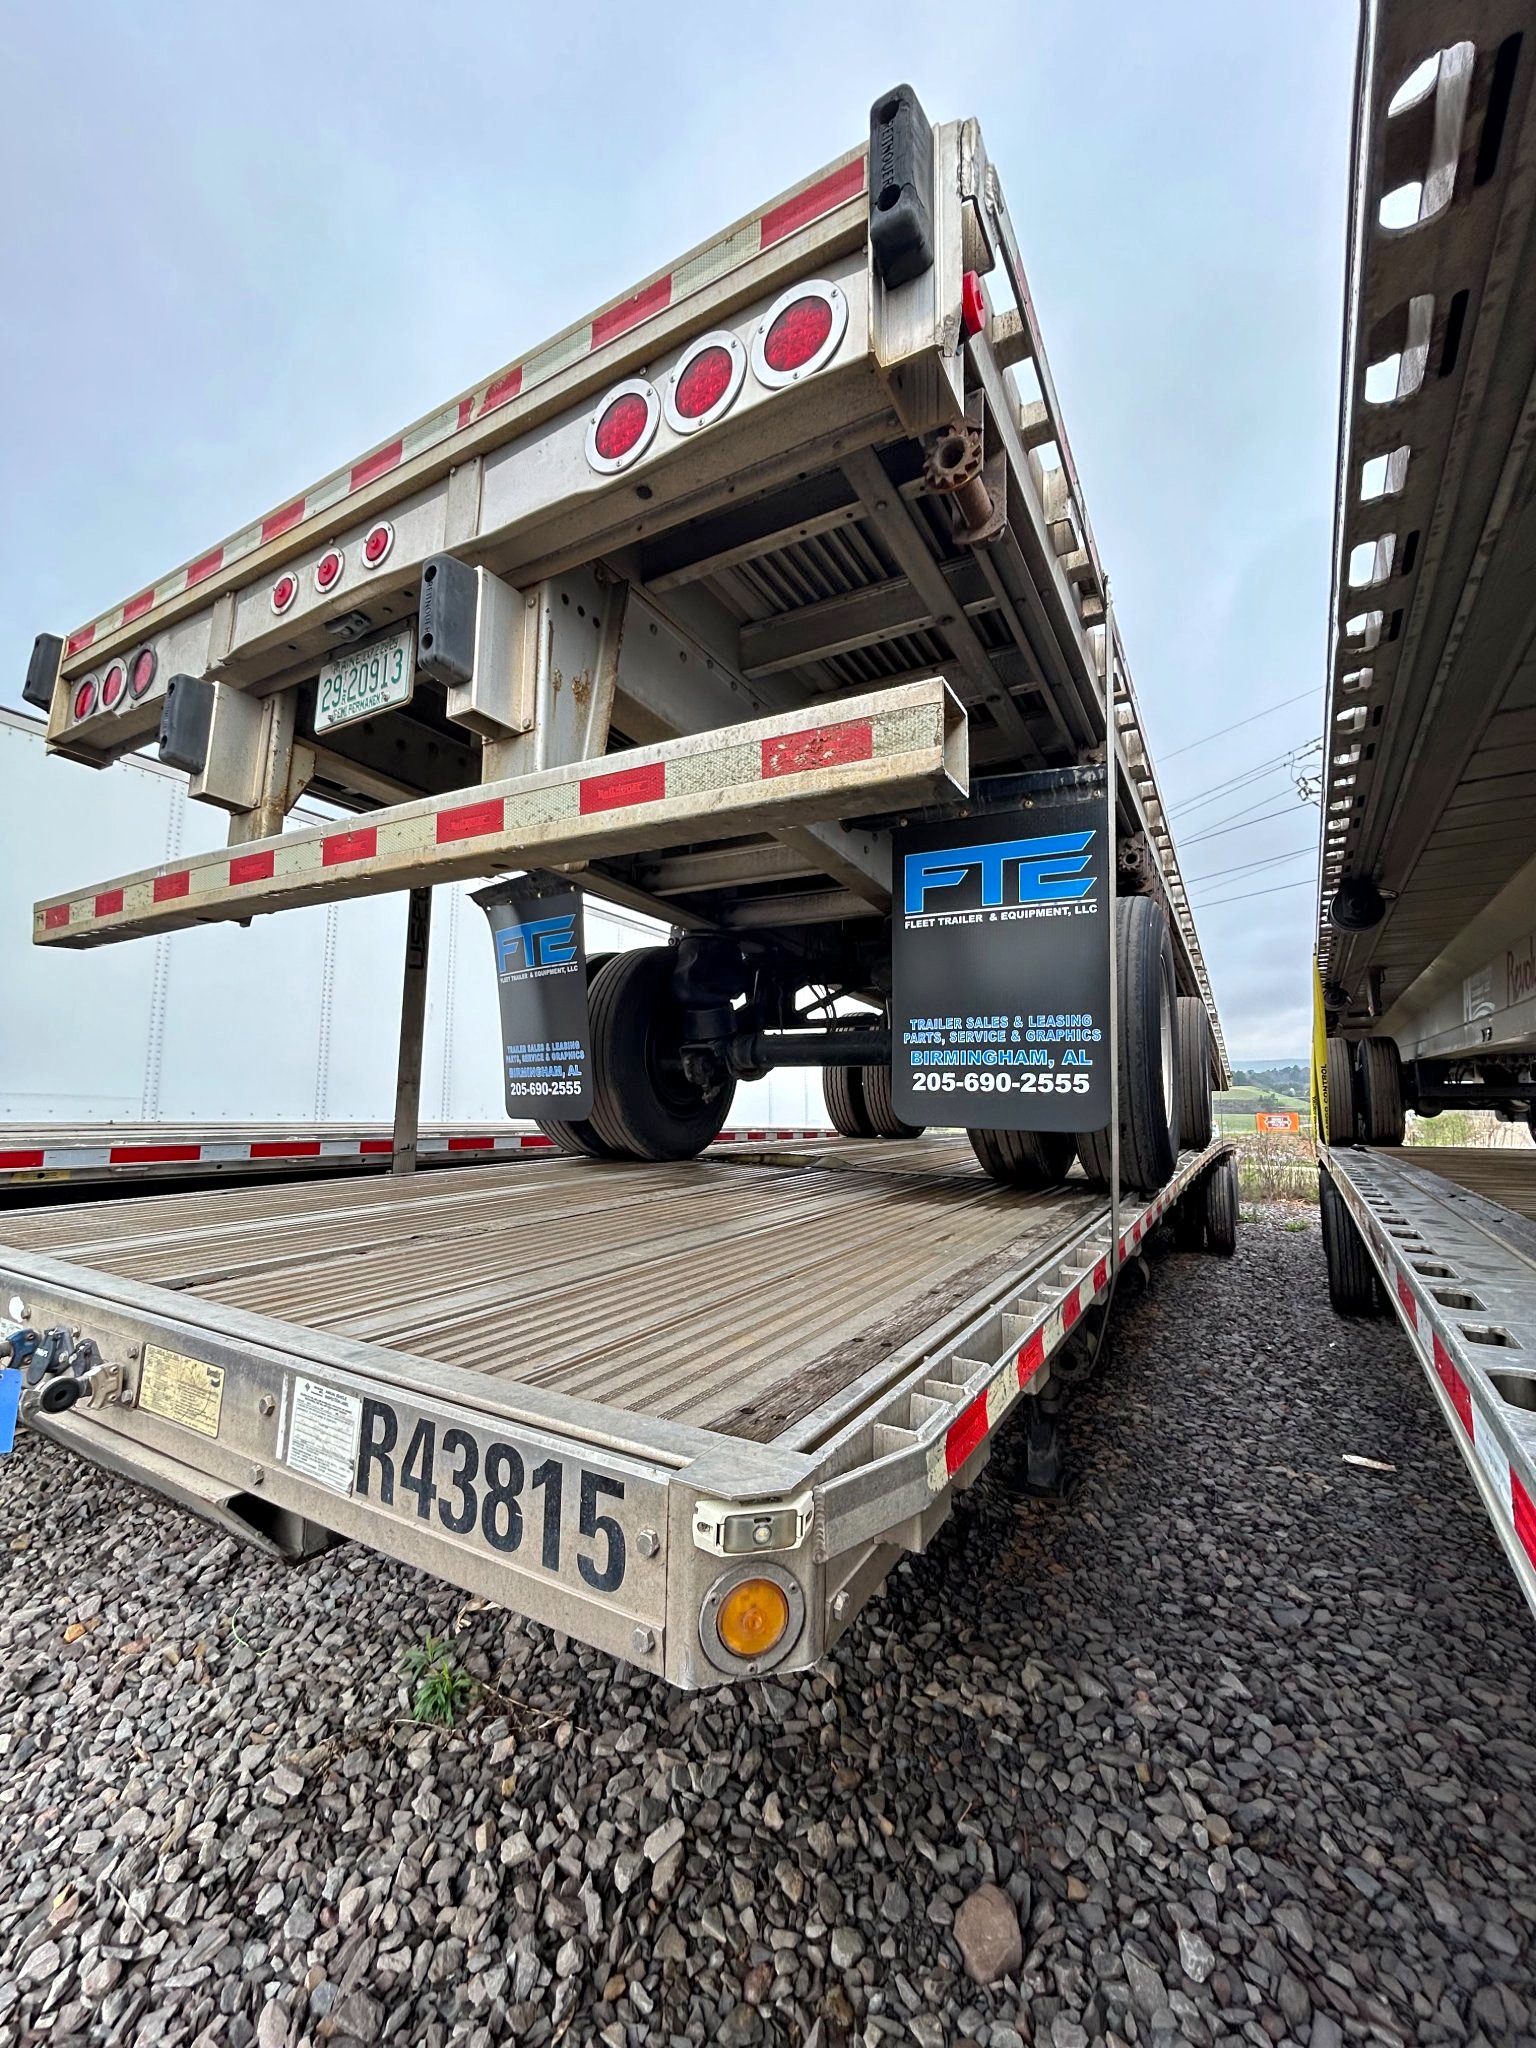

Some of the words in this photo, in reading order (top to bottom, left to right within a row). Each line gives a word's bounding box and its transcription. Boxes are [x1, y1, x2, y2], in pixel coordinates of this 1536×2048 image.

[905, 829, 1097, 914] FTE
[904, 917, 935, 930] FLEET
[938, 914, 983, 927] TRAILER
[989, 912, 998, 921] &
[1001, 907, 1071, 921] EQUIPMENT,
[1075, 904, 1098, 915] LLC
[495, 913, 577, 974] FTE
[534, 967, 566, 978] EQUIPMENT,
[567, 965, 578, 973] LLC
[910, 1017, 962, 1031] TRAILER
[966, 1016, 1009, 1030] SALES
[1013, 1016, 1023, 1028] &
[1028, 1014, 1093, 1028] LEASING
[551, 1040, 581, 1051] LEASING
[903, 1032, 946, 1046] PARTS,
[949, 1030, 1006, 1044] SERVICE
[1011, 1029, 1021, 1042] &
[1026, 1029, 1102, 1042] GRAPHICS
[551, 1049, 586, 1061] GRAPHICS
[910, 1049, 1055, 1069] BIRMINGHAM,
[1062, 1049, 1093, 1066] AL
[508, 1066, 566, 1080] BIRMINGHAM,
[567, 1064, 582, 1076] AL
[510, 1080, 582, 1097] 205-690-2555
[911, 1072, 1091, 1094] 205-690-2555
[356, 1397, 626, 1592] R43815
